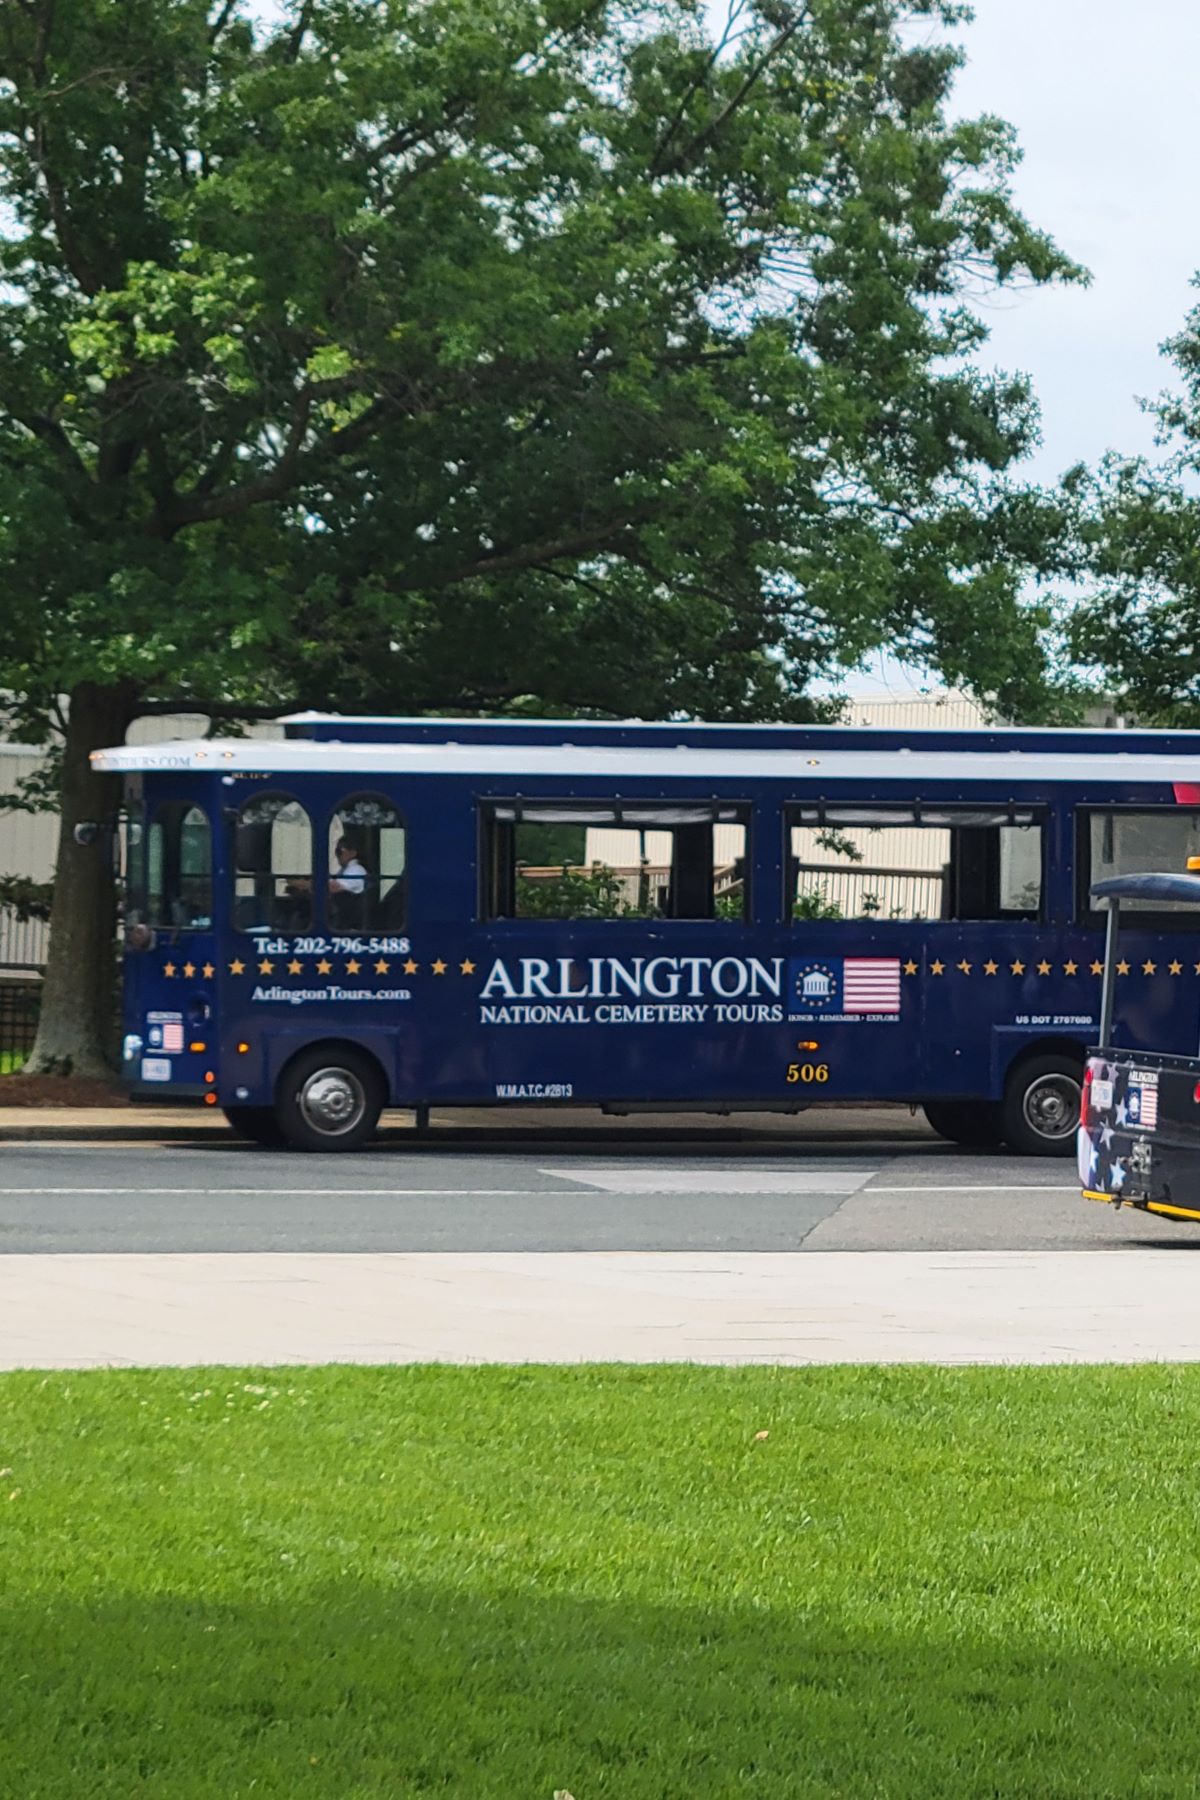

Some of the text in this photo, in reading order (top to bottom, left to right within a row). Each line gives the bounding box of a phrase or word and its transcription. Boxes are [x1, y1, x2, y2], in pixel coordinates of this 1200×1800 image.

[253, 937, 410, 954] Tel: 202-796-5488
[479, 957, 785, 998] ARLINGTON
[252, 986, 411, 1004] ArlingtonTours.com
[480, 1004, 783, 1023] NATIONAL CEMETERY TOURS
[1016, 1015, 1029, 1024] US
[1031, 1015, 1051, 1024] DOT
[786, 1063, 829, 1082] 506
